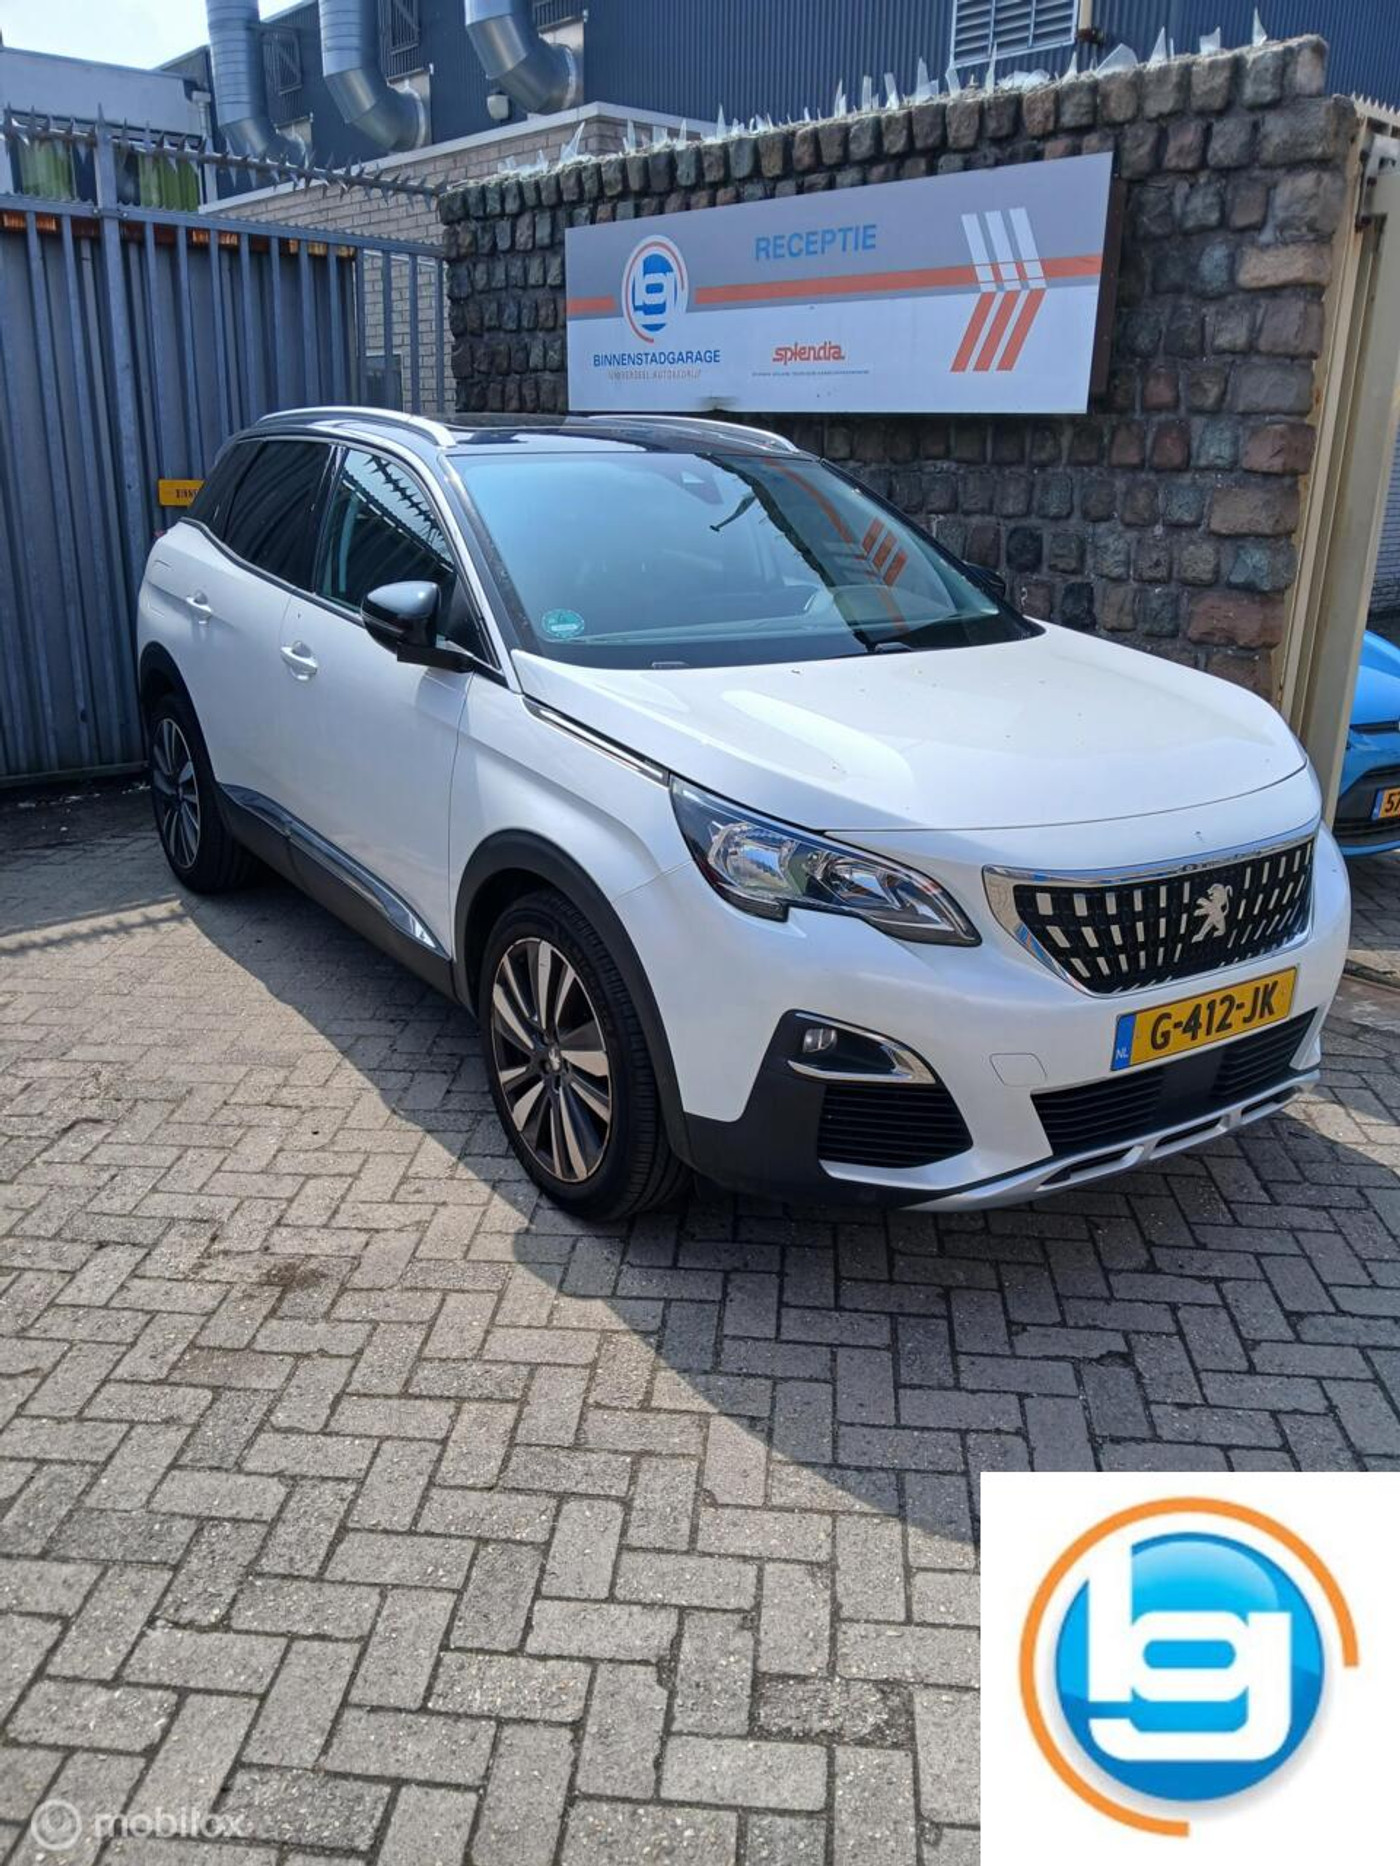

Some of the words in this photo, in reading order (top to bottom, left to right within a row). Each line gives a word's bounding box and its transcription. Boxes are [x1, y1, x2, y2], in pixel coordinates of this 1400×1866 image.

[755, 224, 877, 261] RECEPTIE
[593, 350, 721, 367] BINNENSTADGARAGE
[1151, 980, 1278, 1050] G-412-JK
[1115, 1049, 1129, 1059] NL
